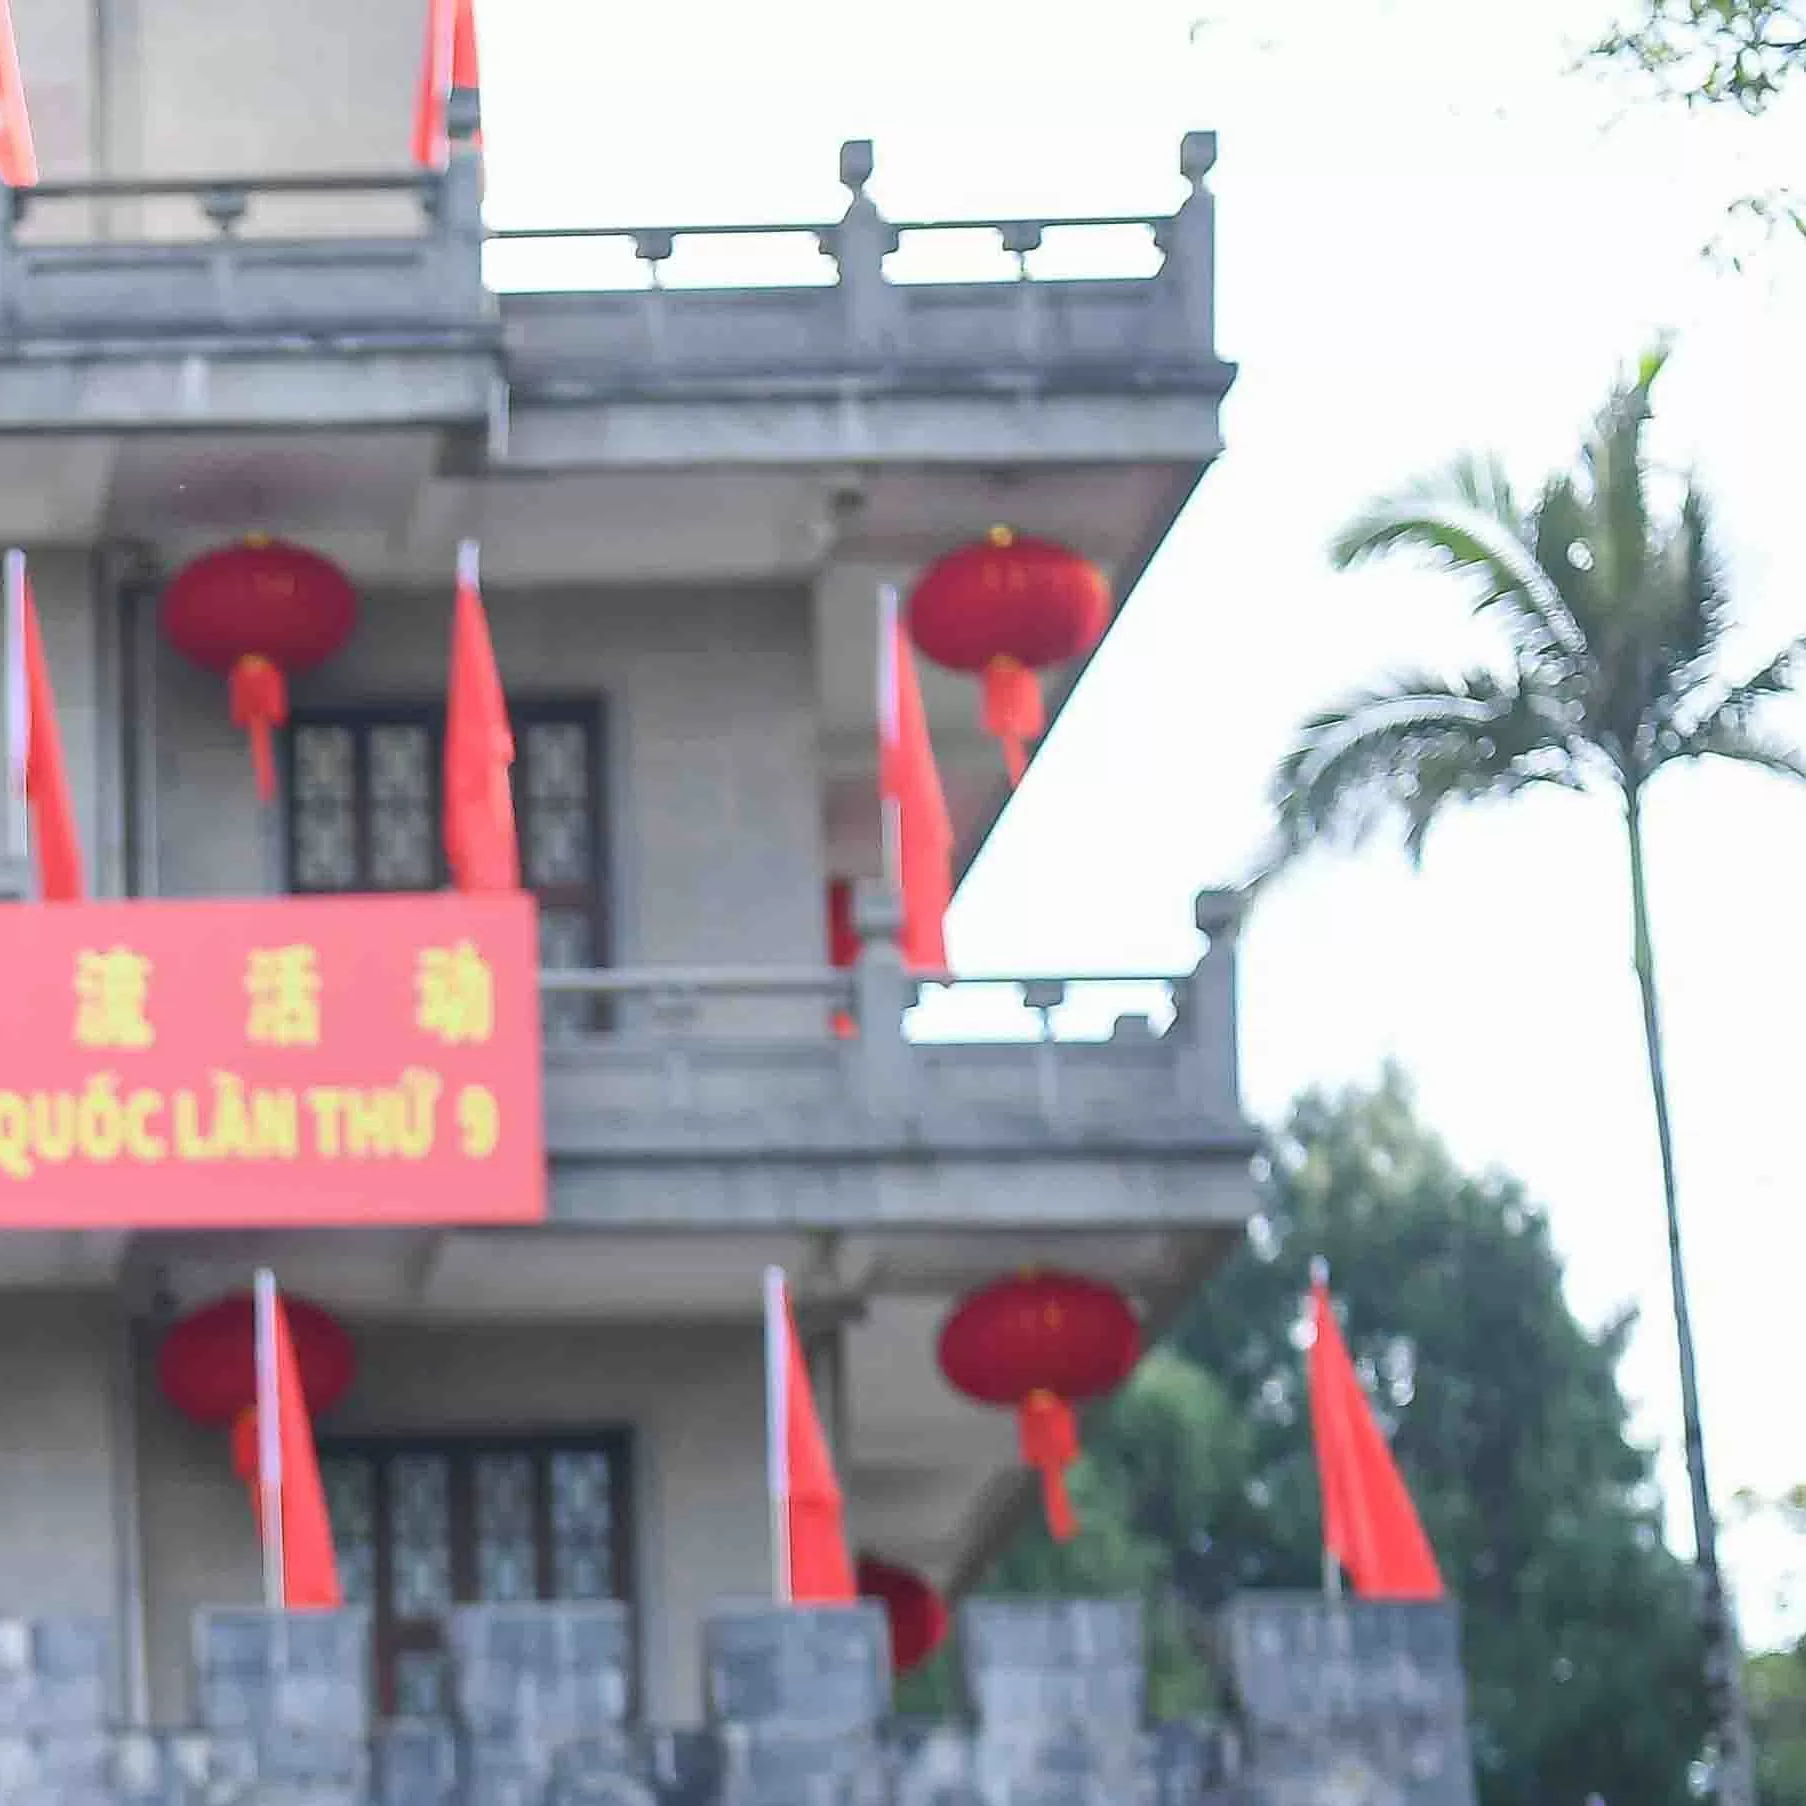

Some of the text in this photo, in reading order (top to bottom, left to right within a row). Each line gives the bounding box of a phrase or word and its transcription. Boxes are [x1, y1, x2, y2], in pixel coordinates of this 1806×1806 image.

[174, 1070, 298, 1160] LẦN
[305, 1068, 441, 1158] THỨ
[457, 1084, 499, 1158] 9
